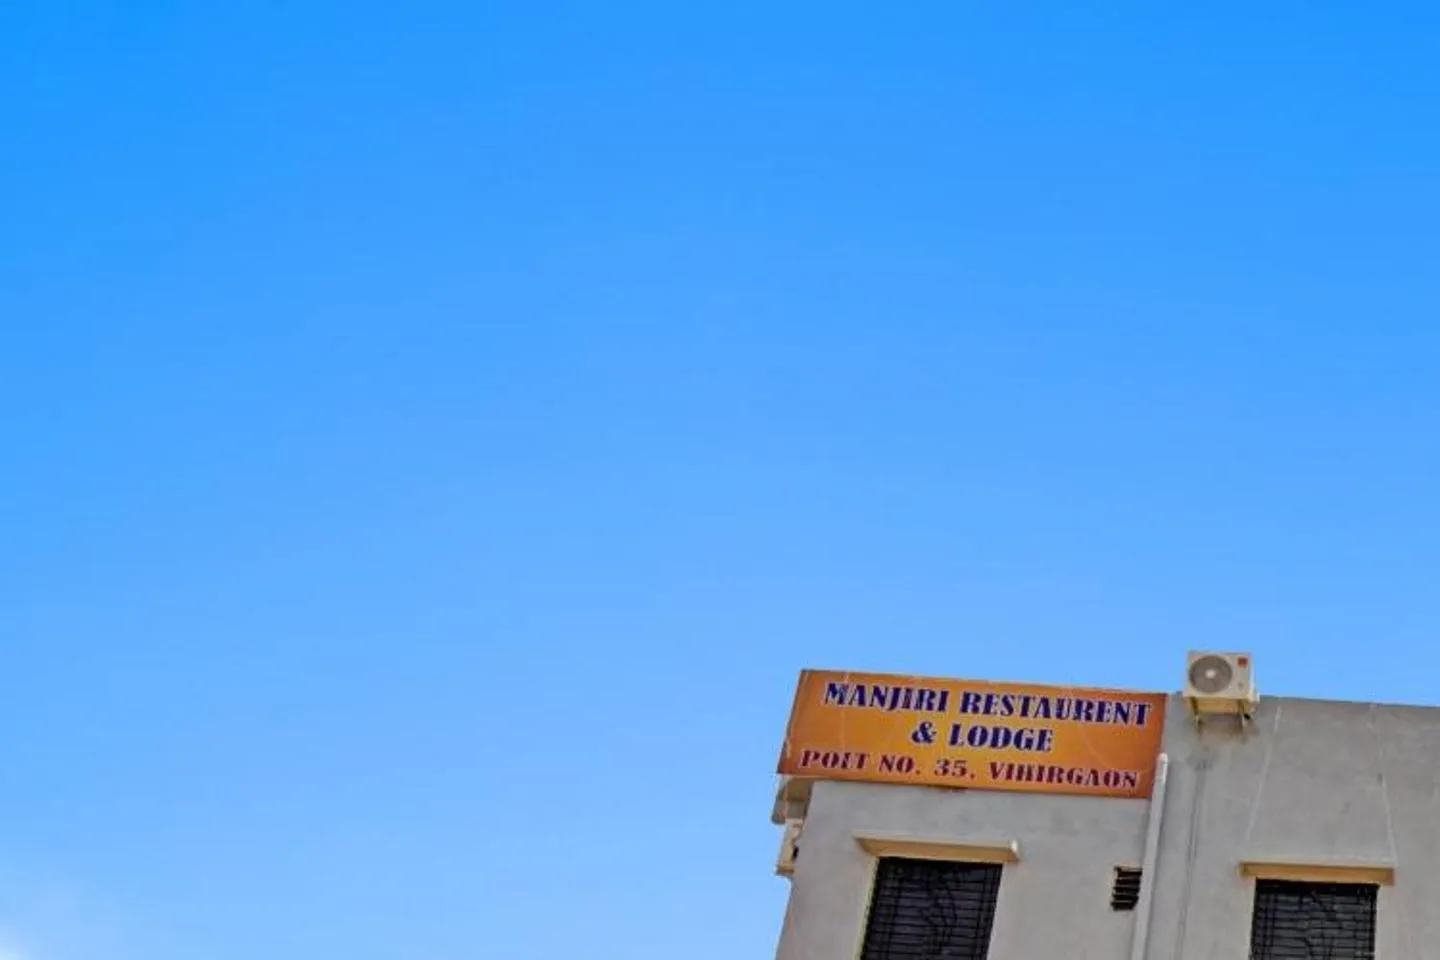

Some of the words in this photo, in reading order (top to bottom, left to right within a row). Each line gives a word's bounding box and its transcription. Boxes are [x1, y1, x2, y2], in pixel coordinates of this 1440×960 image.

[825, 682, 950, 712] MANJIRI
[958, 690, 1150, 725] RESTAURENT
[911, 720, 938, 743] &
[949, 723, 1055, 752] LODGE
[878, 754, 921, 775] NO.
[988, 758, 1138, 788] VIHIRGAON
